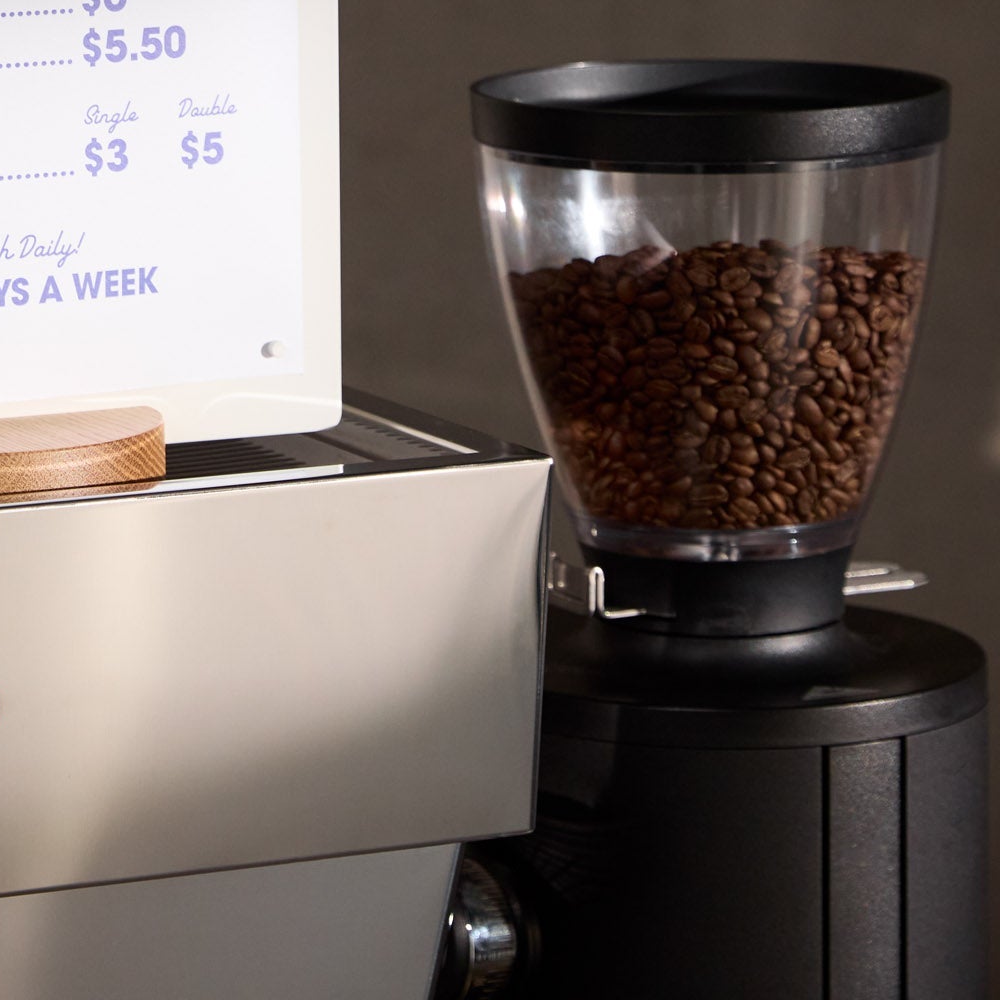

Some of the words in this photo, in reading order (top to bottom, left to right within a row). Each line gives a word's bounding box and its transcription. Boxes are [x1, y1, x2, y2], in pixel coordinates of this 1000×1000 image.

[82, 25, 186, 67] $5.50
[84, 101, 138, 133] Single
[178, 94, 236, 118] Double
[85, 137, 129, 177] $3
[181, 130, 224, 168] $5
[20, 232, 85, 268] Daily!
[39, 276, 63, 304] A
[72, 266, 158, 300] WEEK
